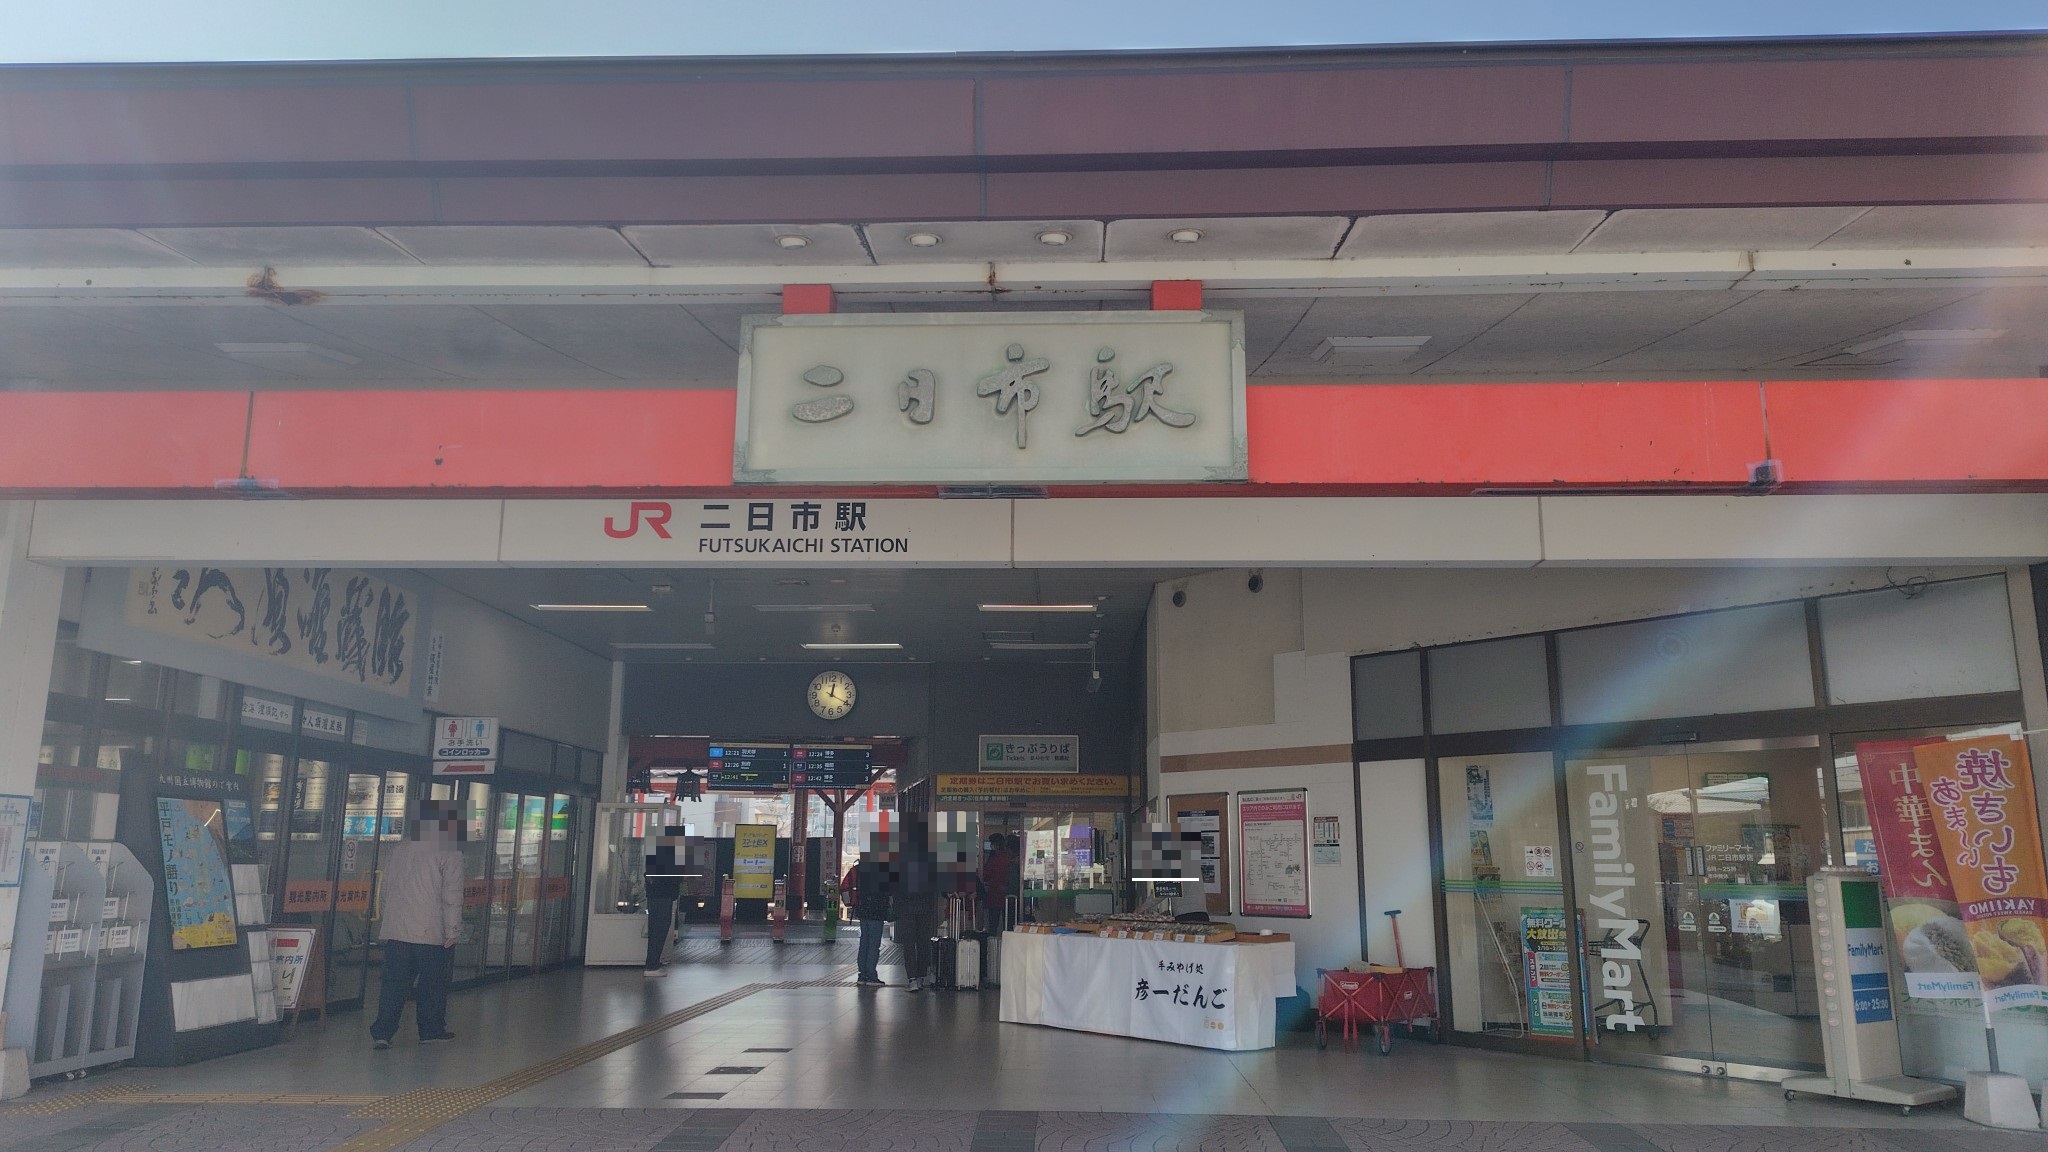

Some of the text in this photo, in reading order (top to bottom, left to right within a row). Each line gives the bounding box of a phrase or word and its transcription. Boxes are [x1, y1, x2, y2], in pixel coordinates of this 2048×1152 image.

[604, 502, 672, 539] JR
[700, 501, 867, 532] 二日市駅
[699, 538, 909, 553] FUTSUKAICHI STATION
[448, 739, 483, 747] お手洗い
[1005, 743, 1070, 754] きっぷうりば
[441, 748, 488, 756] コインロッカー
[337, 890, 369, 903] 光案内所
[1586, 764, 1645, 1032] FamilyMart
[1848, 943, 1884, 957] FamilyMart
[1158, 960, 1204, 975] 手みやげ処
[1135, 978, 1228, 1010] 彦一だんご
